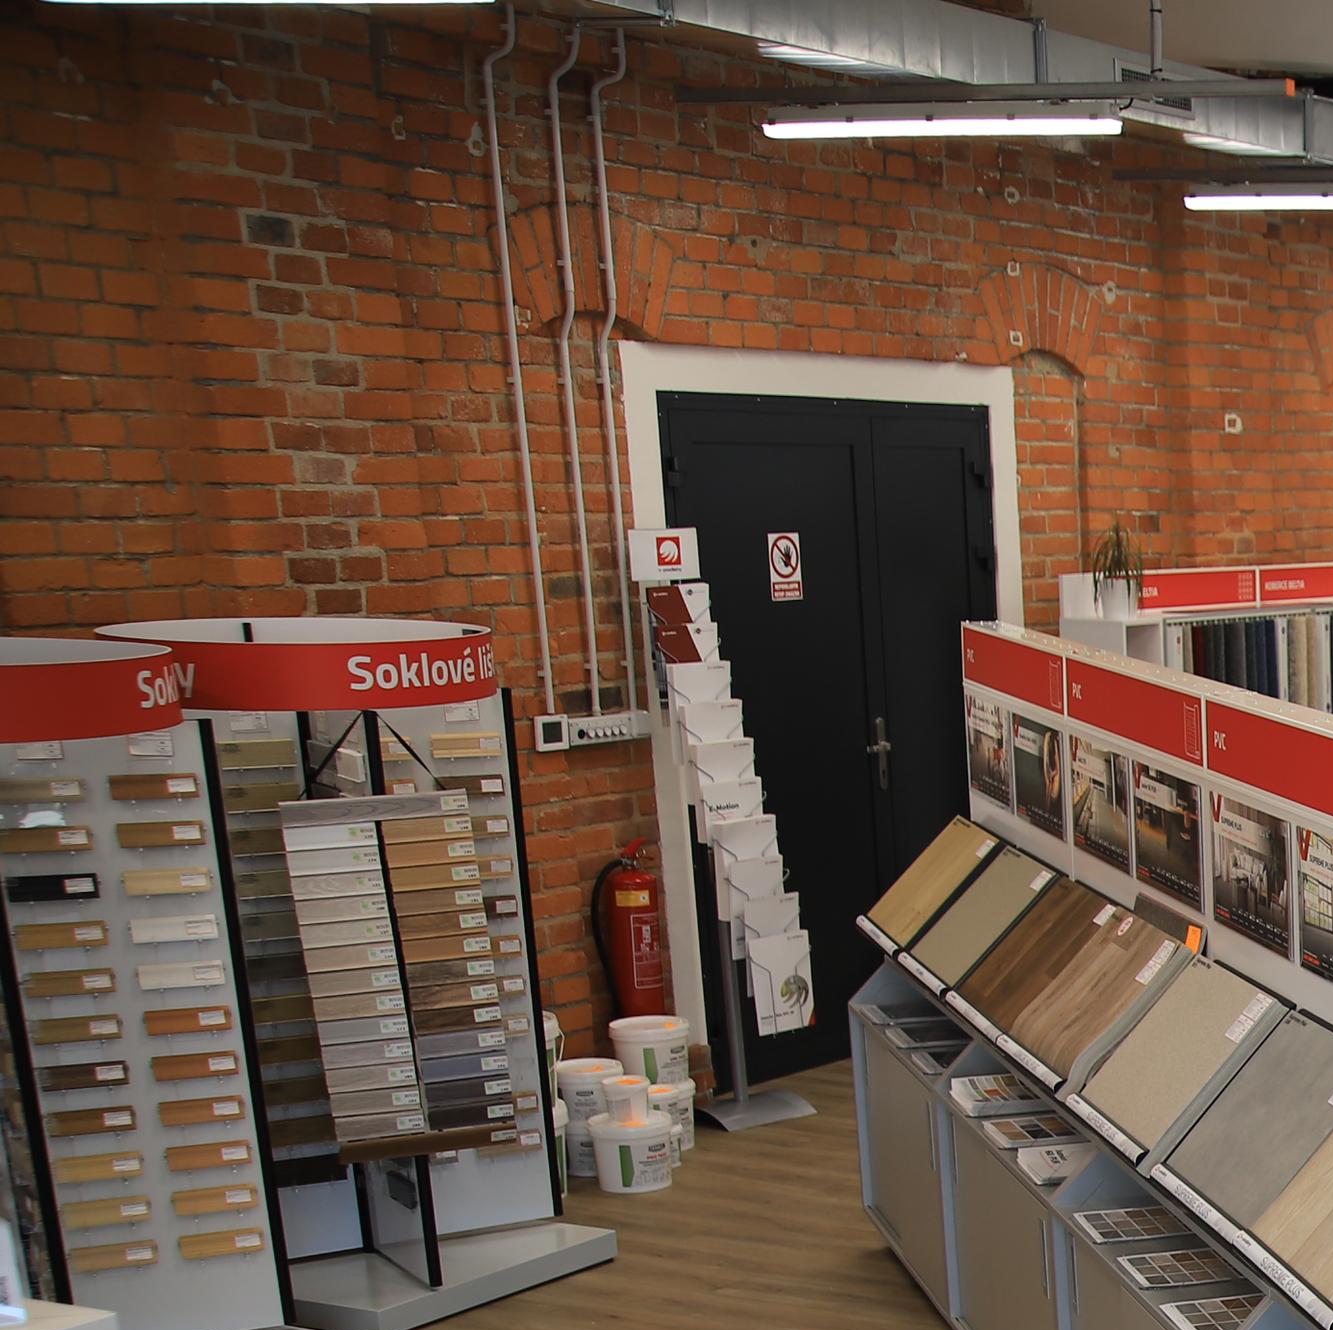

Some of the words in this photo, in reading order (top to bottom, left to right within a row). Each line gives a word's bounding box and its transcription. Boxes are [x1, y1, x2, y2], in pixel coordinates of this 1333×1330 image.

[347, 645, 475, 692] Soklové
[1072, 682, 1082, 700] PVC
[1214, 730, 1226, 751] PVC
[1259, 1256, 1290, 1286] SUPREME
[1286, 1276, 1305, 1300] PLUS
